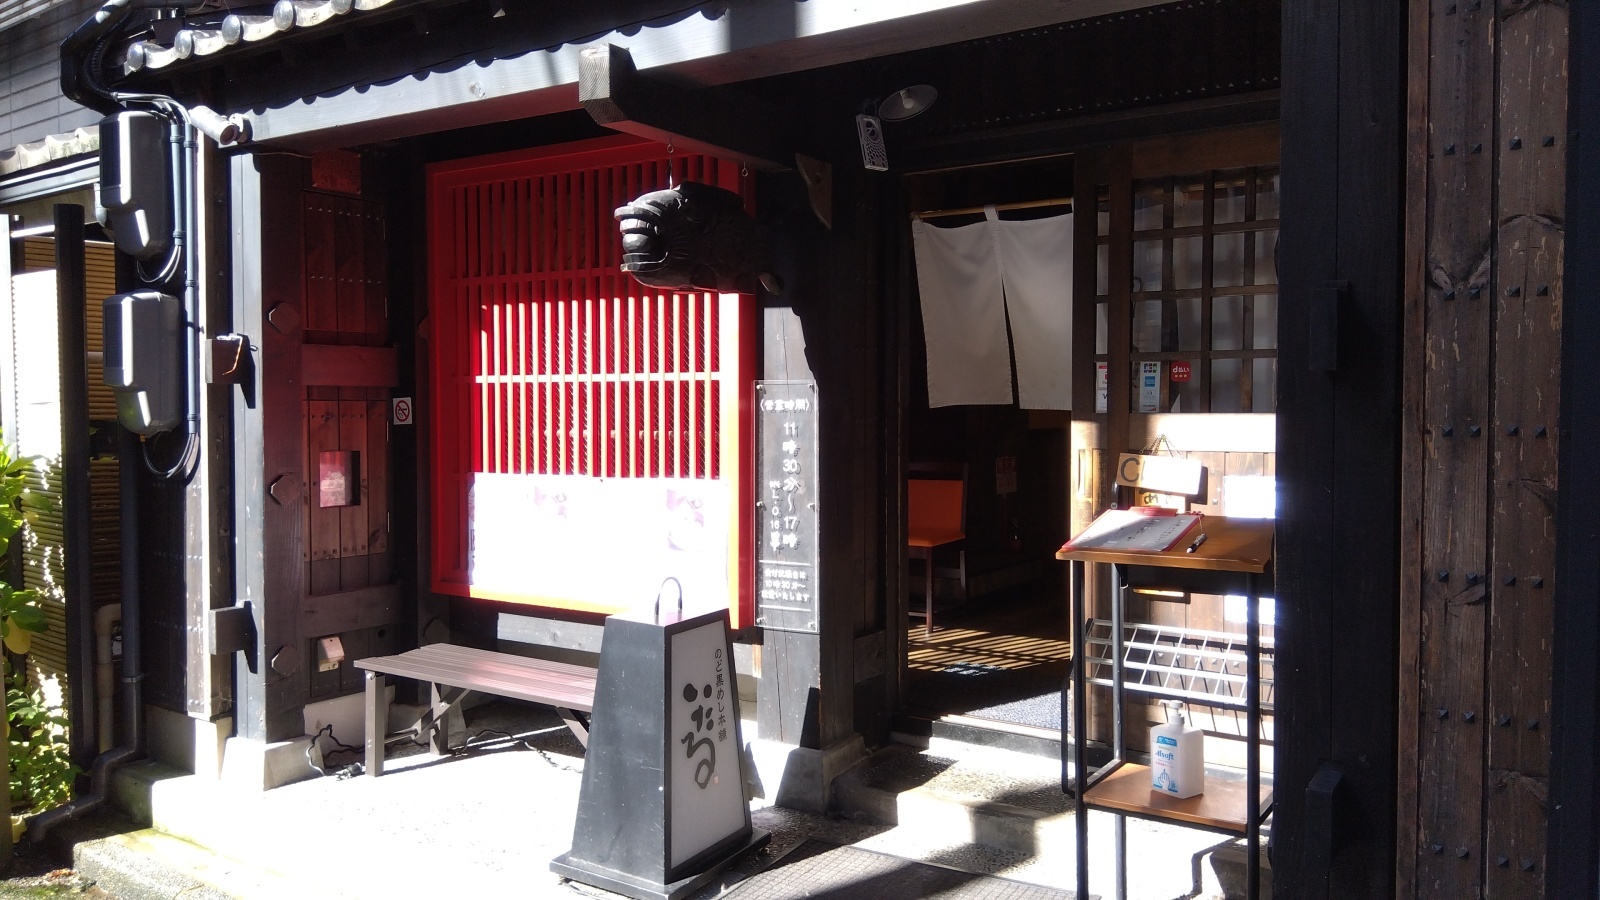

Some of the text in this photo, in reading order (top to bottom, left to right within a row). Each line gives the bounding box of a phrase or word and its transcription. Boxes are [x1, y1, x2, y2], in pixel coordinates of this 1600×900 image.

[714, 648, 728, 743] のど黒めし本舗
[1155, 750, 1175, 761] Alsoft
